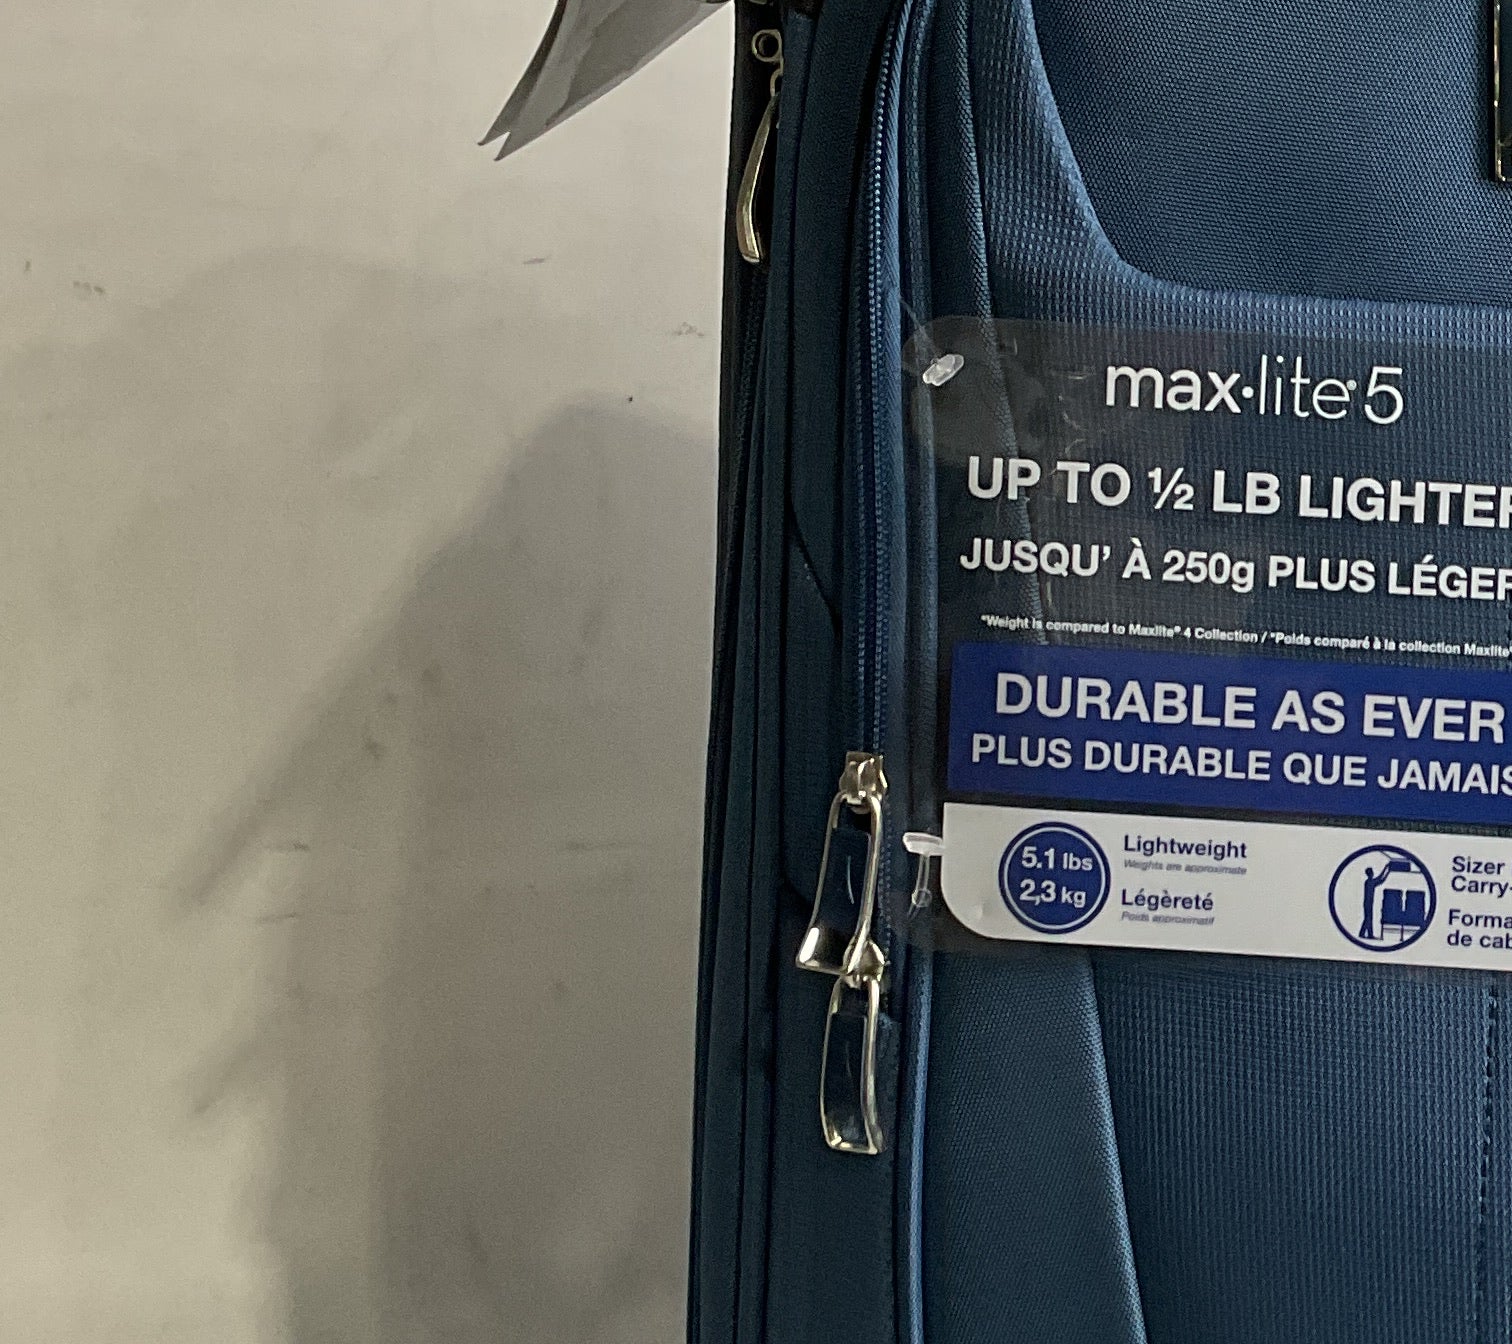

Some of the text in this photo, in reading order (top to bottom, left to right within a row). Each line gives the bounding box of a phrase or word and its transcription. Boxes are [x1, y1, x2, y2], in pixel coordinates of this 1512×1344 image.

[968, 455, 1042, 501] UP
[1056, 460, 1131, 507] TO
[1212, 469, 1281, 514] LB
[1121, 536, 1152, 580] À
[1161, 548, 1256, 593] 250g
[1267, 555, 1376, 593] PLUS
[1031, 617, 1043, 631] is
[1046, 619, 1110, 636] compared
[1112, 623, 1126, 636] to
[1183, 628, 1192, 639] 4
[1194, 626, 1259, 643] Collection
[1313, 635, 1371, 651] comparé
[1373, 636, 1382, 650] à
[1383, 637, 1396, 651] la
[1399, 639, 1462, 655] collection
[995, 672, 1506, 744] DURABLE AS EVER
[971, 732, 1073, 769] PLUS
[1084, 739, 1272, 782] DURABLE
[1283, 751, 1368, 787] QUE
[1021, 845, 1093, 872] 5.1 lbs
[1123, 834, 1248, 861] Lightweight
[1451, 855, 1506, 875] Sizer
[1019, 878, 1087, 908] 2,3 kg
[1120, 888, 1215, 912] Légèreté
[1446, 929, 1474, 948] de
